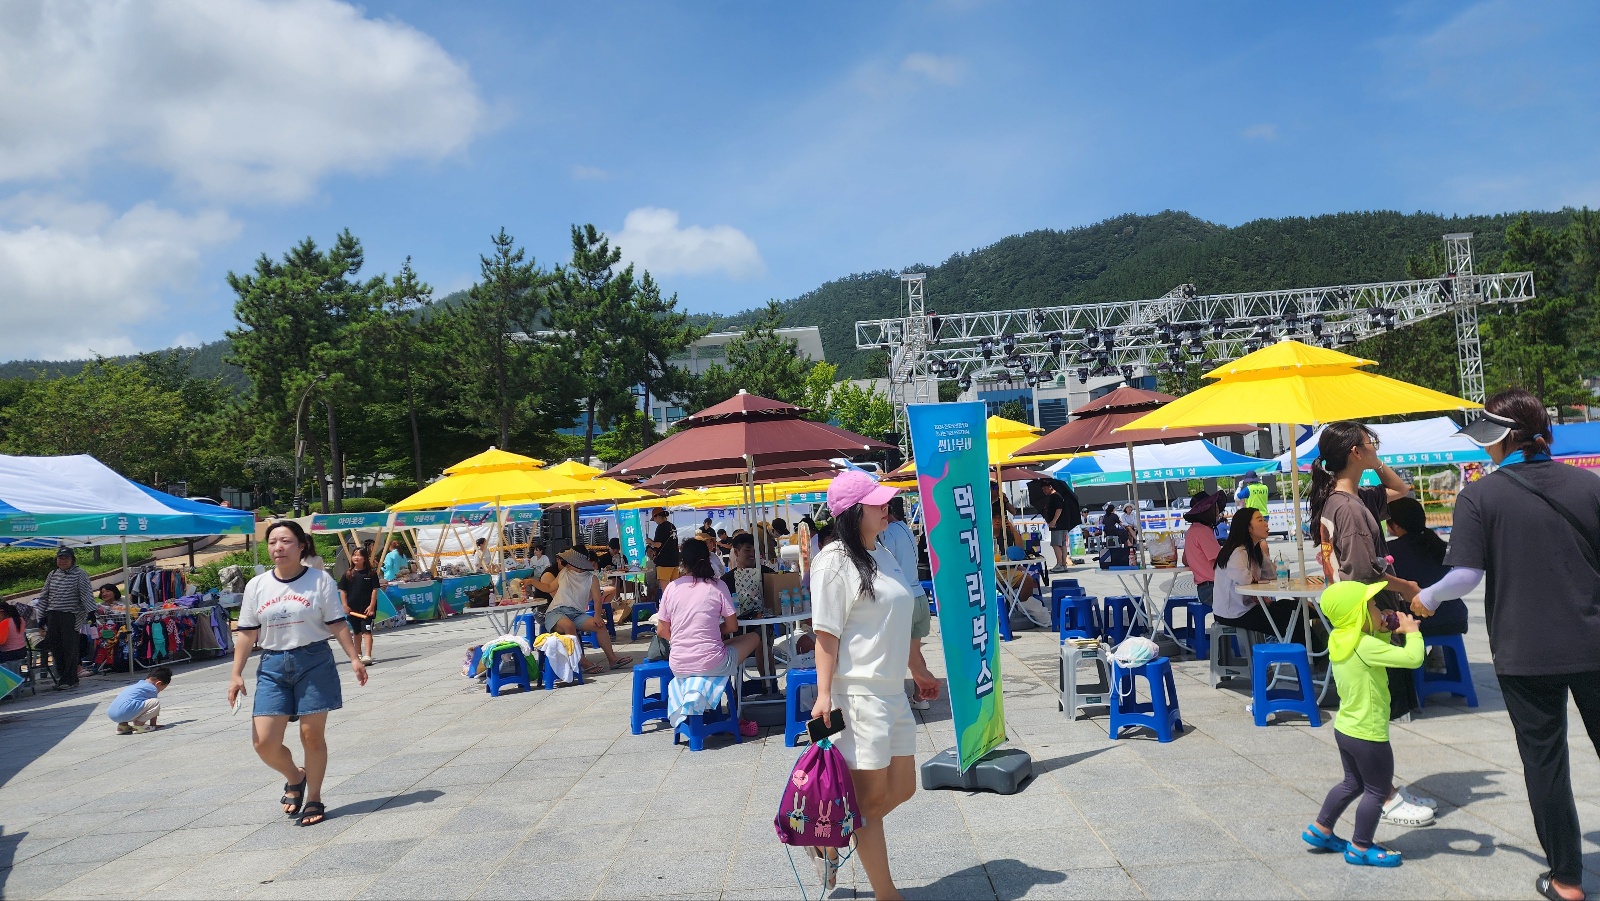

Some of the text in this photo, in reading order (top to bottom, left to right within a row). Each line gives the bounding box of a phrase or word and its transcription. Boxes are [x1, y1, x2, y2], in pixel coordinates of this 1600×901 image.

[1384, 452, 1454, 464] 보호자대기실
[118, 516, 149, 531] 공방
[337, 516, 366, 526] 아이옷장
[953, 483, 994, 699] 먹거리부스
[257, 594, 312, 615] HAWAII SUMMER
